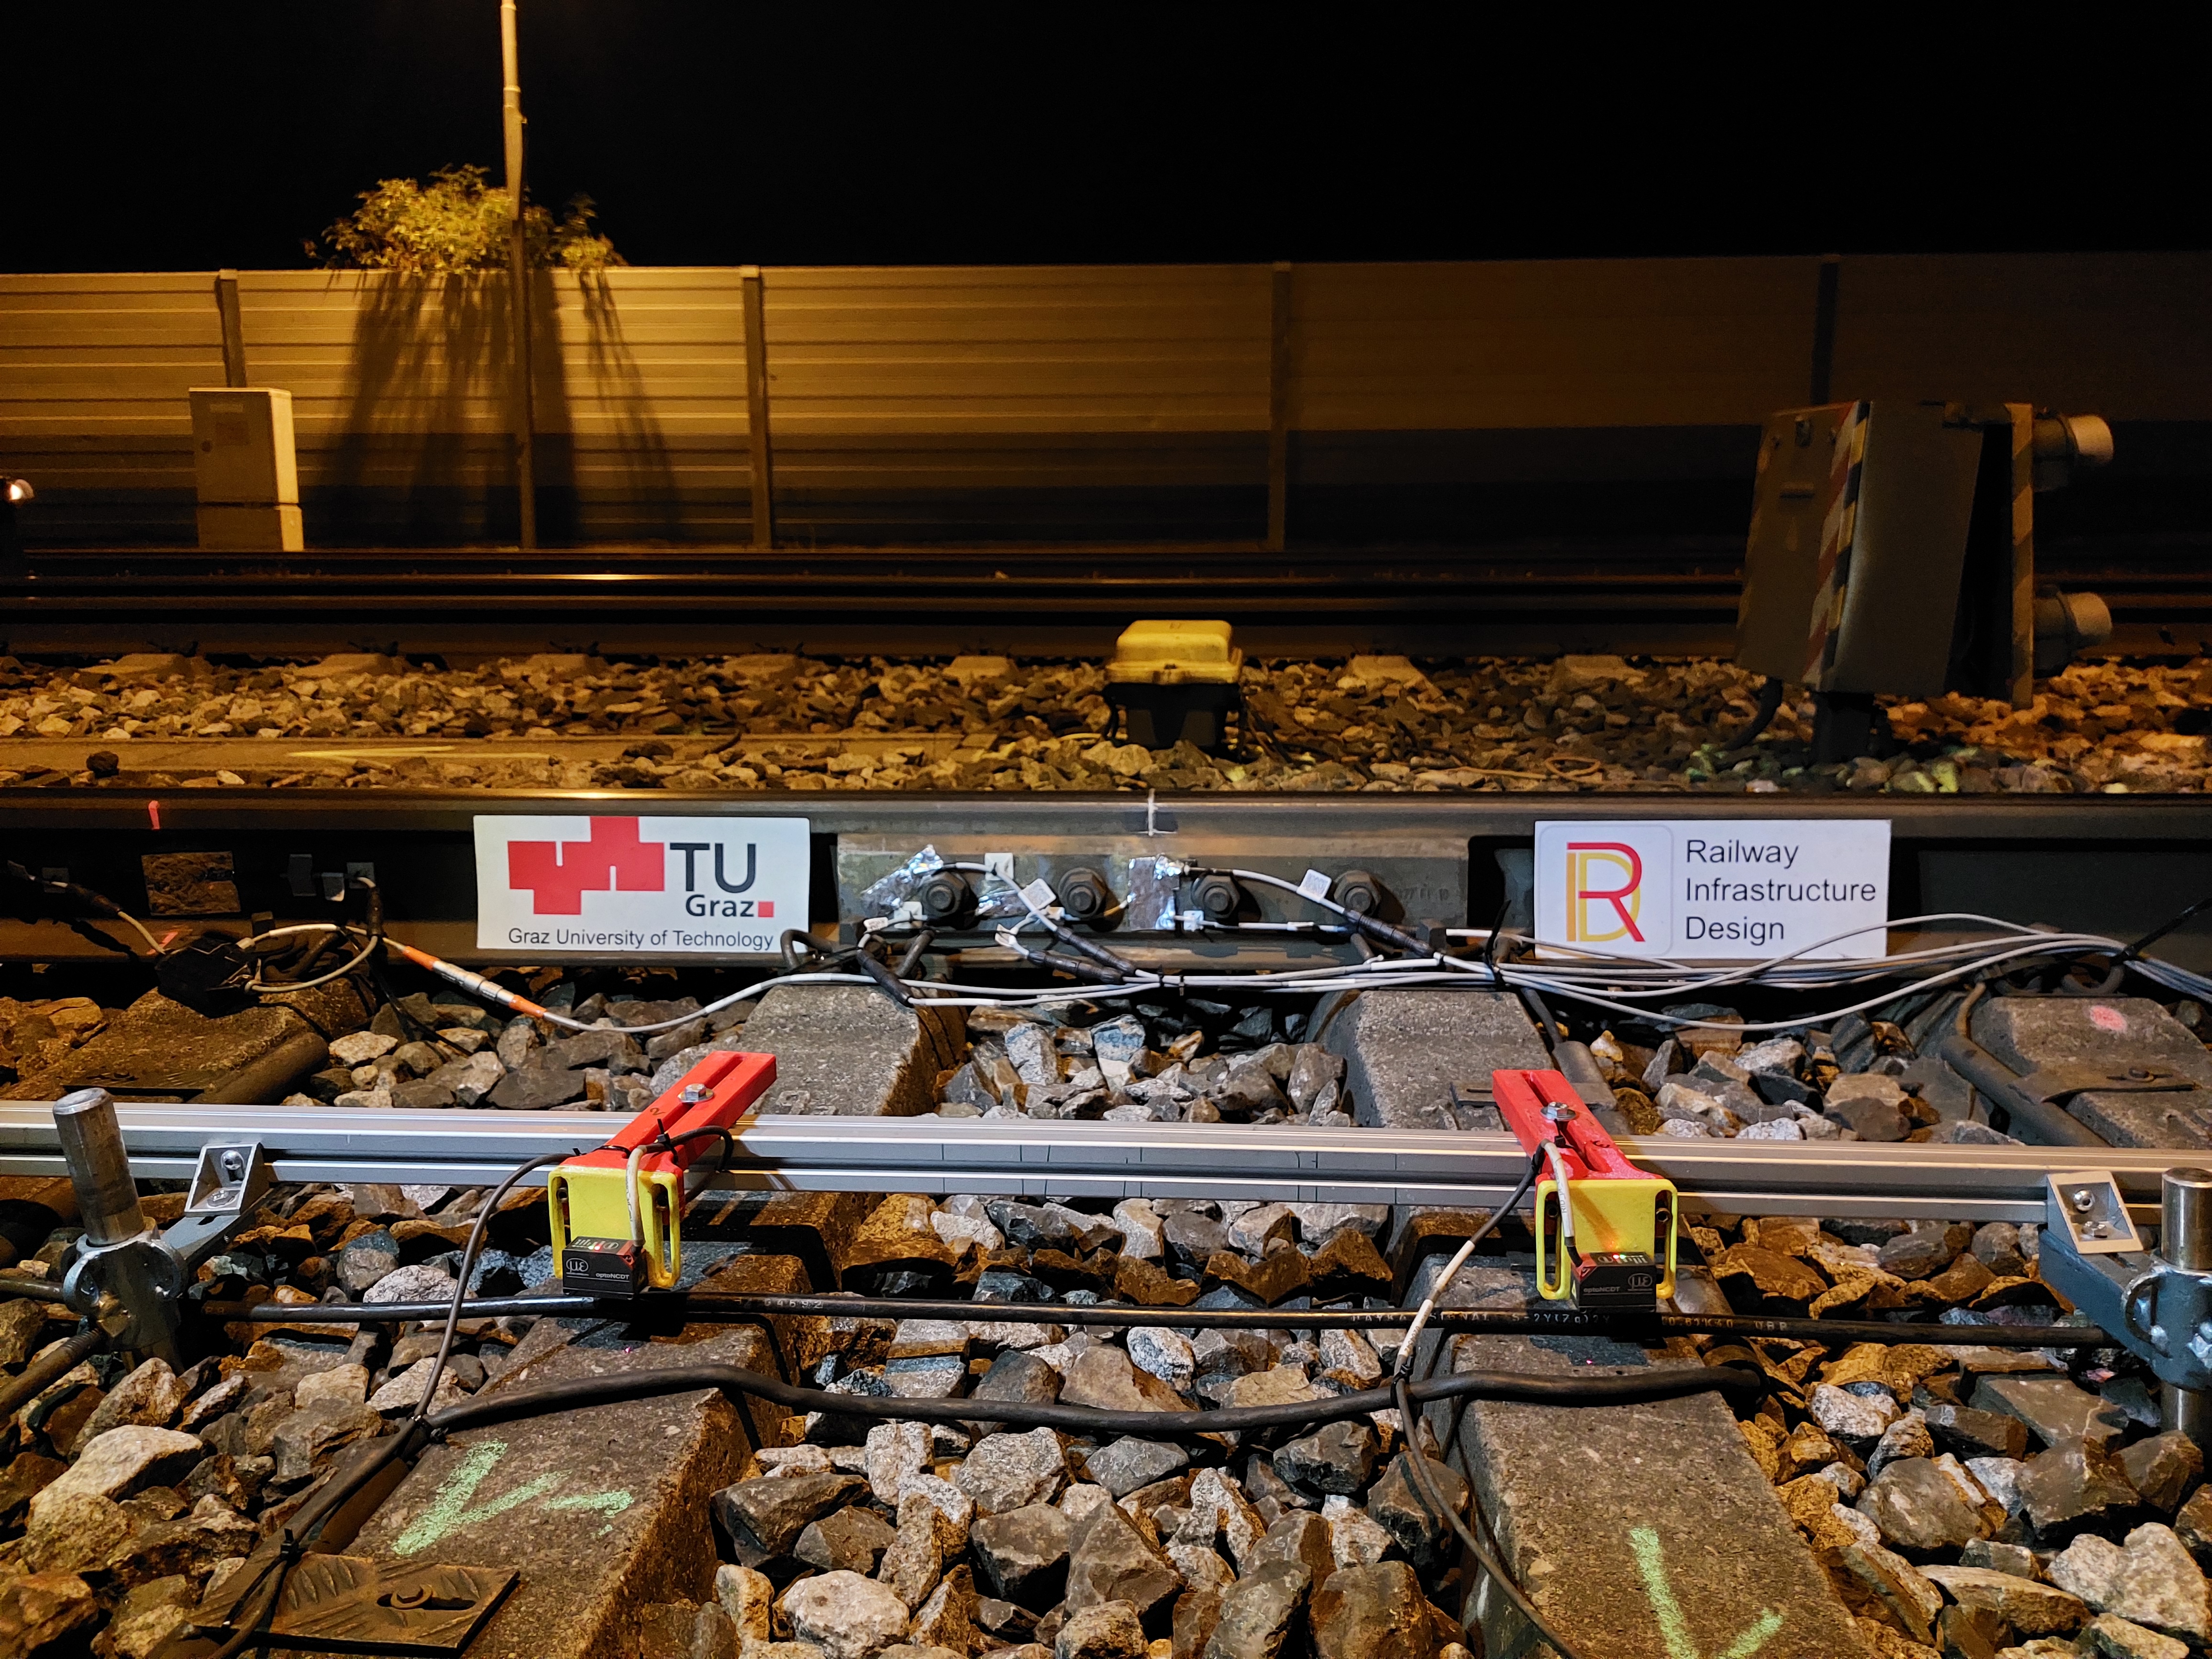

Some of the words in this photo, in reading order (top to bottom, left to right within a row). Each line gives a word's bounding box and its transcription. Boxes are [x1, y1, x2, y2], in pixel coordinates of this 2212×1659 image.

[1687, 840, 1799, 869] Railway
[670, 843, 756, 893] TU
[1687, 877, 1876, 901] Infrastructure
[686, 894, 754, 917] Graz
[509, 928, 550, 944] Graz
[557, 929, 644, 949] University
[651, 930, 668, 945] of
[674, 930, 774, 951] Technology
[1686, 916, 1784, 946] Design
